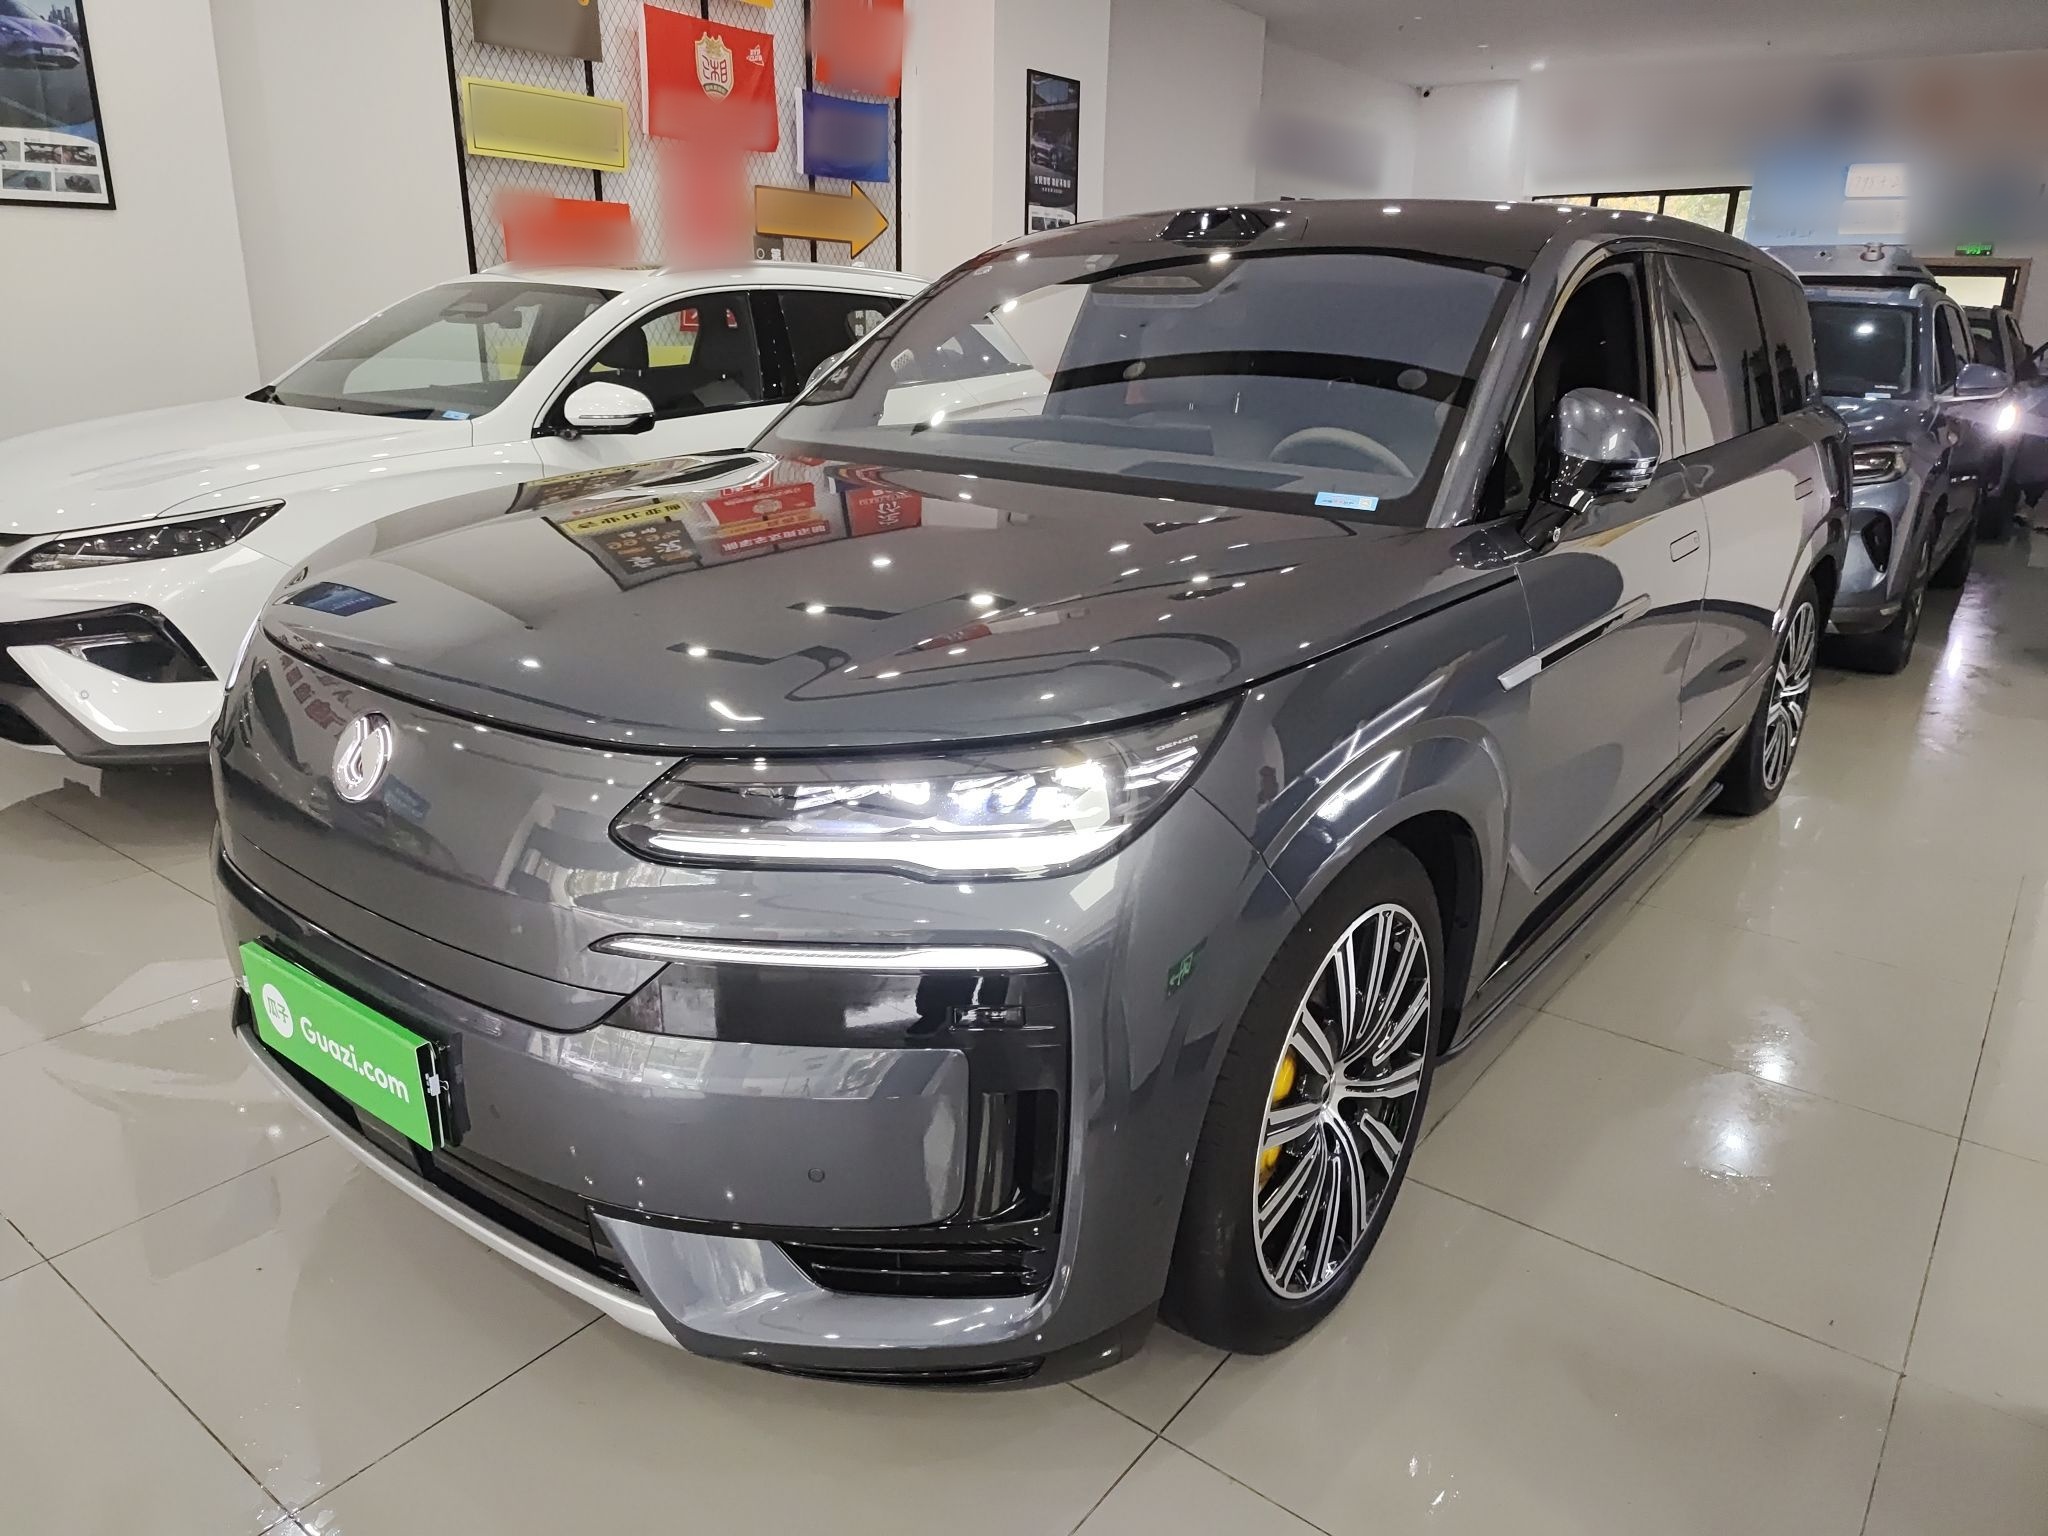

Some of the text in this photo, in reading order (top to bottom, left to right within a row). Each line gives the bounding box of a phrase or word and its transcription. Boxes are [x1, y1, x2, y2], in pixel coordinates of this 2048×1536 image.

[1156, 734, 1199, 752] DENZA
[267, 996, 289, 1024] 瓜子
[300, 1016, 410, 1104] Guazi.com
